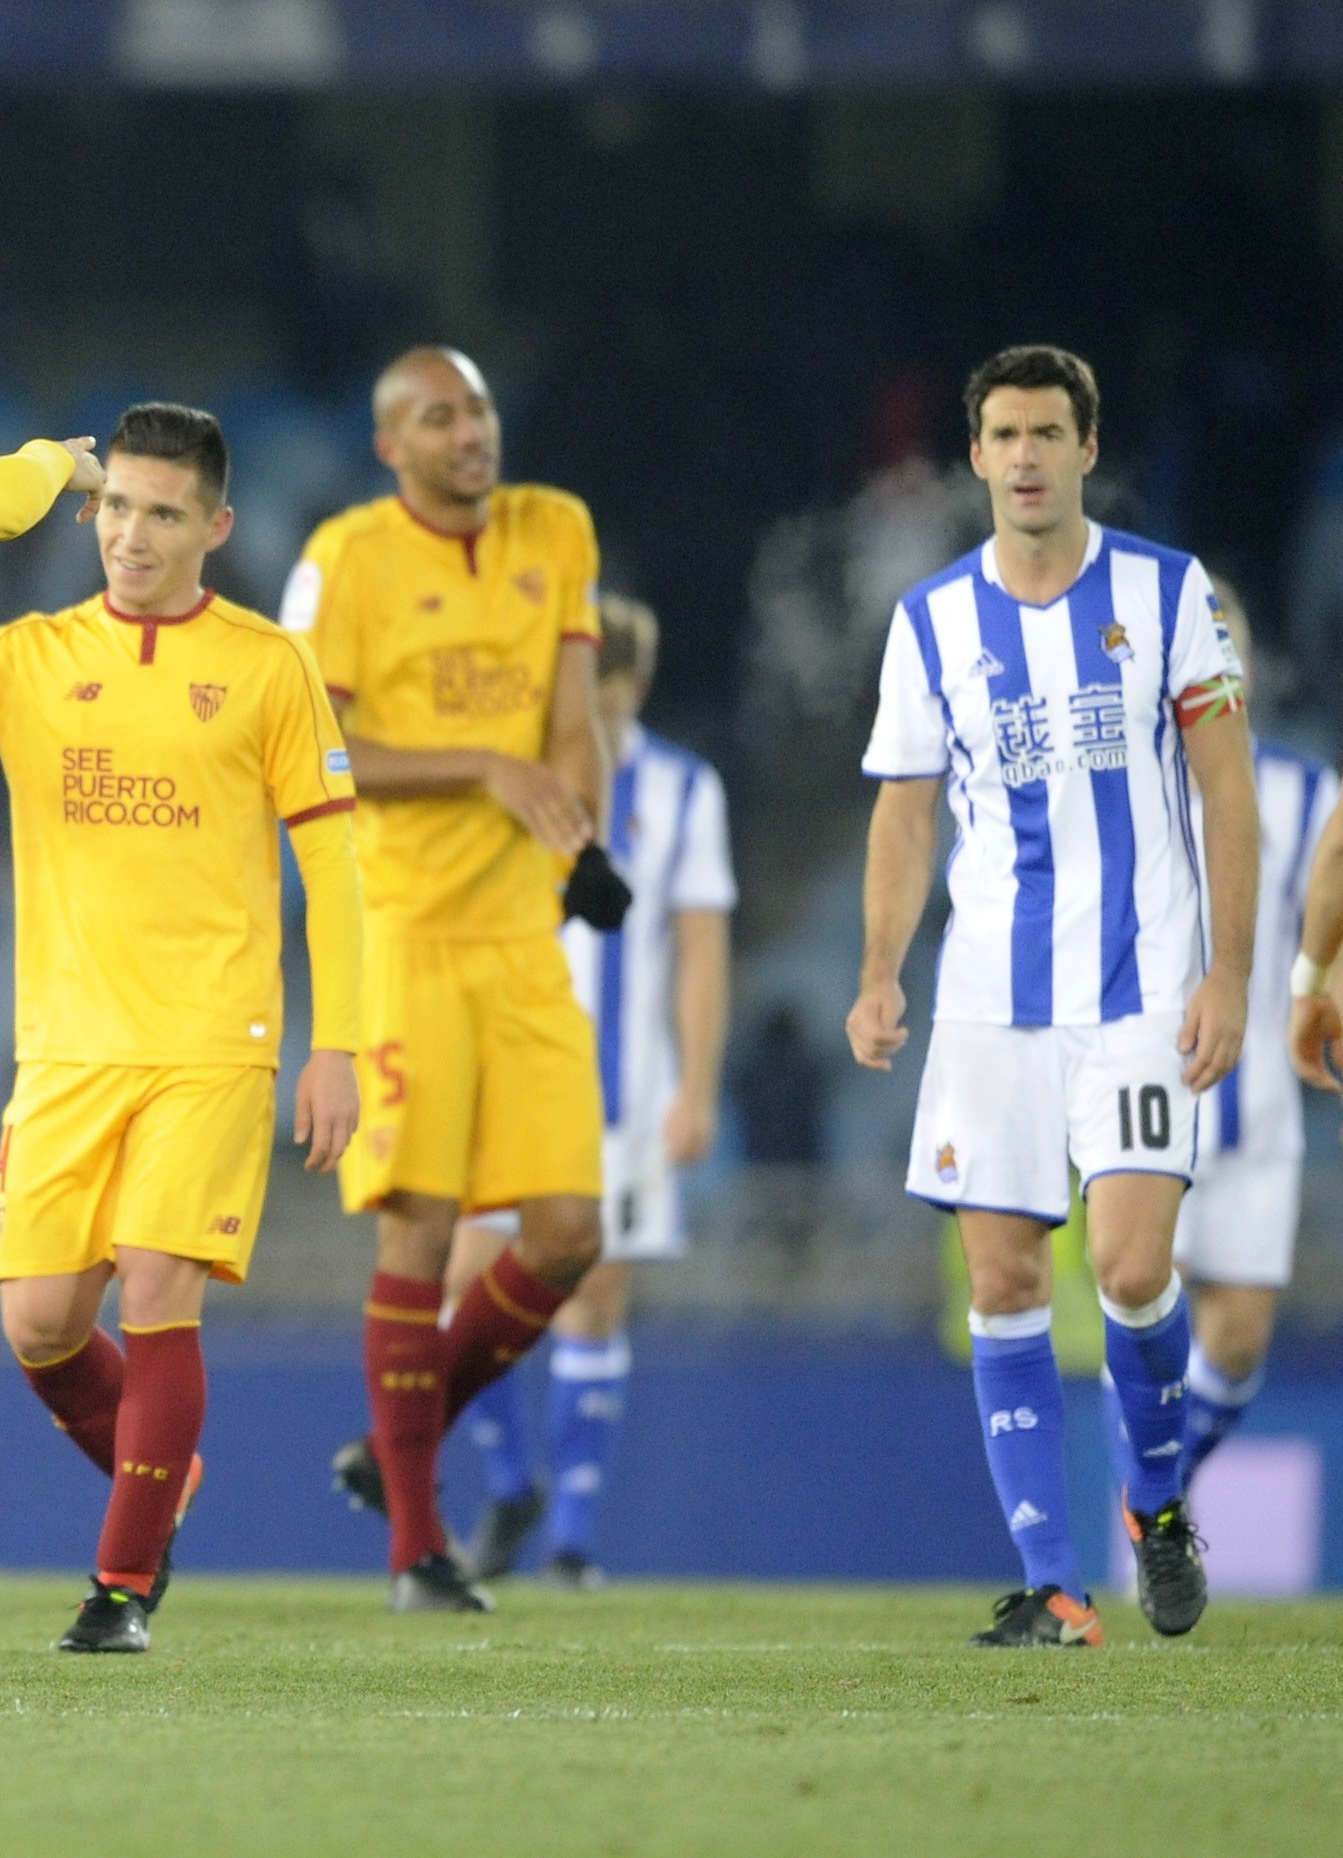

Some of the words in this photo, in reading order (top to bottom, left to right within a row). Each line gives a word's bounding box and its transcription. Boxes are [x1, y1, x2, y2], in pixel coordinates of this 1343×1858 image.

[62, 747, 113, 773] SEE
[1004, 750, 1127, 787] qbao.com
[63, 774, 177, 802] PUERTO
[63, 799, 201, 828] RICO.COM
[1118, 1085, 1171, 1152] 10
[990, 1406, 1038, 1437] RS
